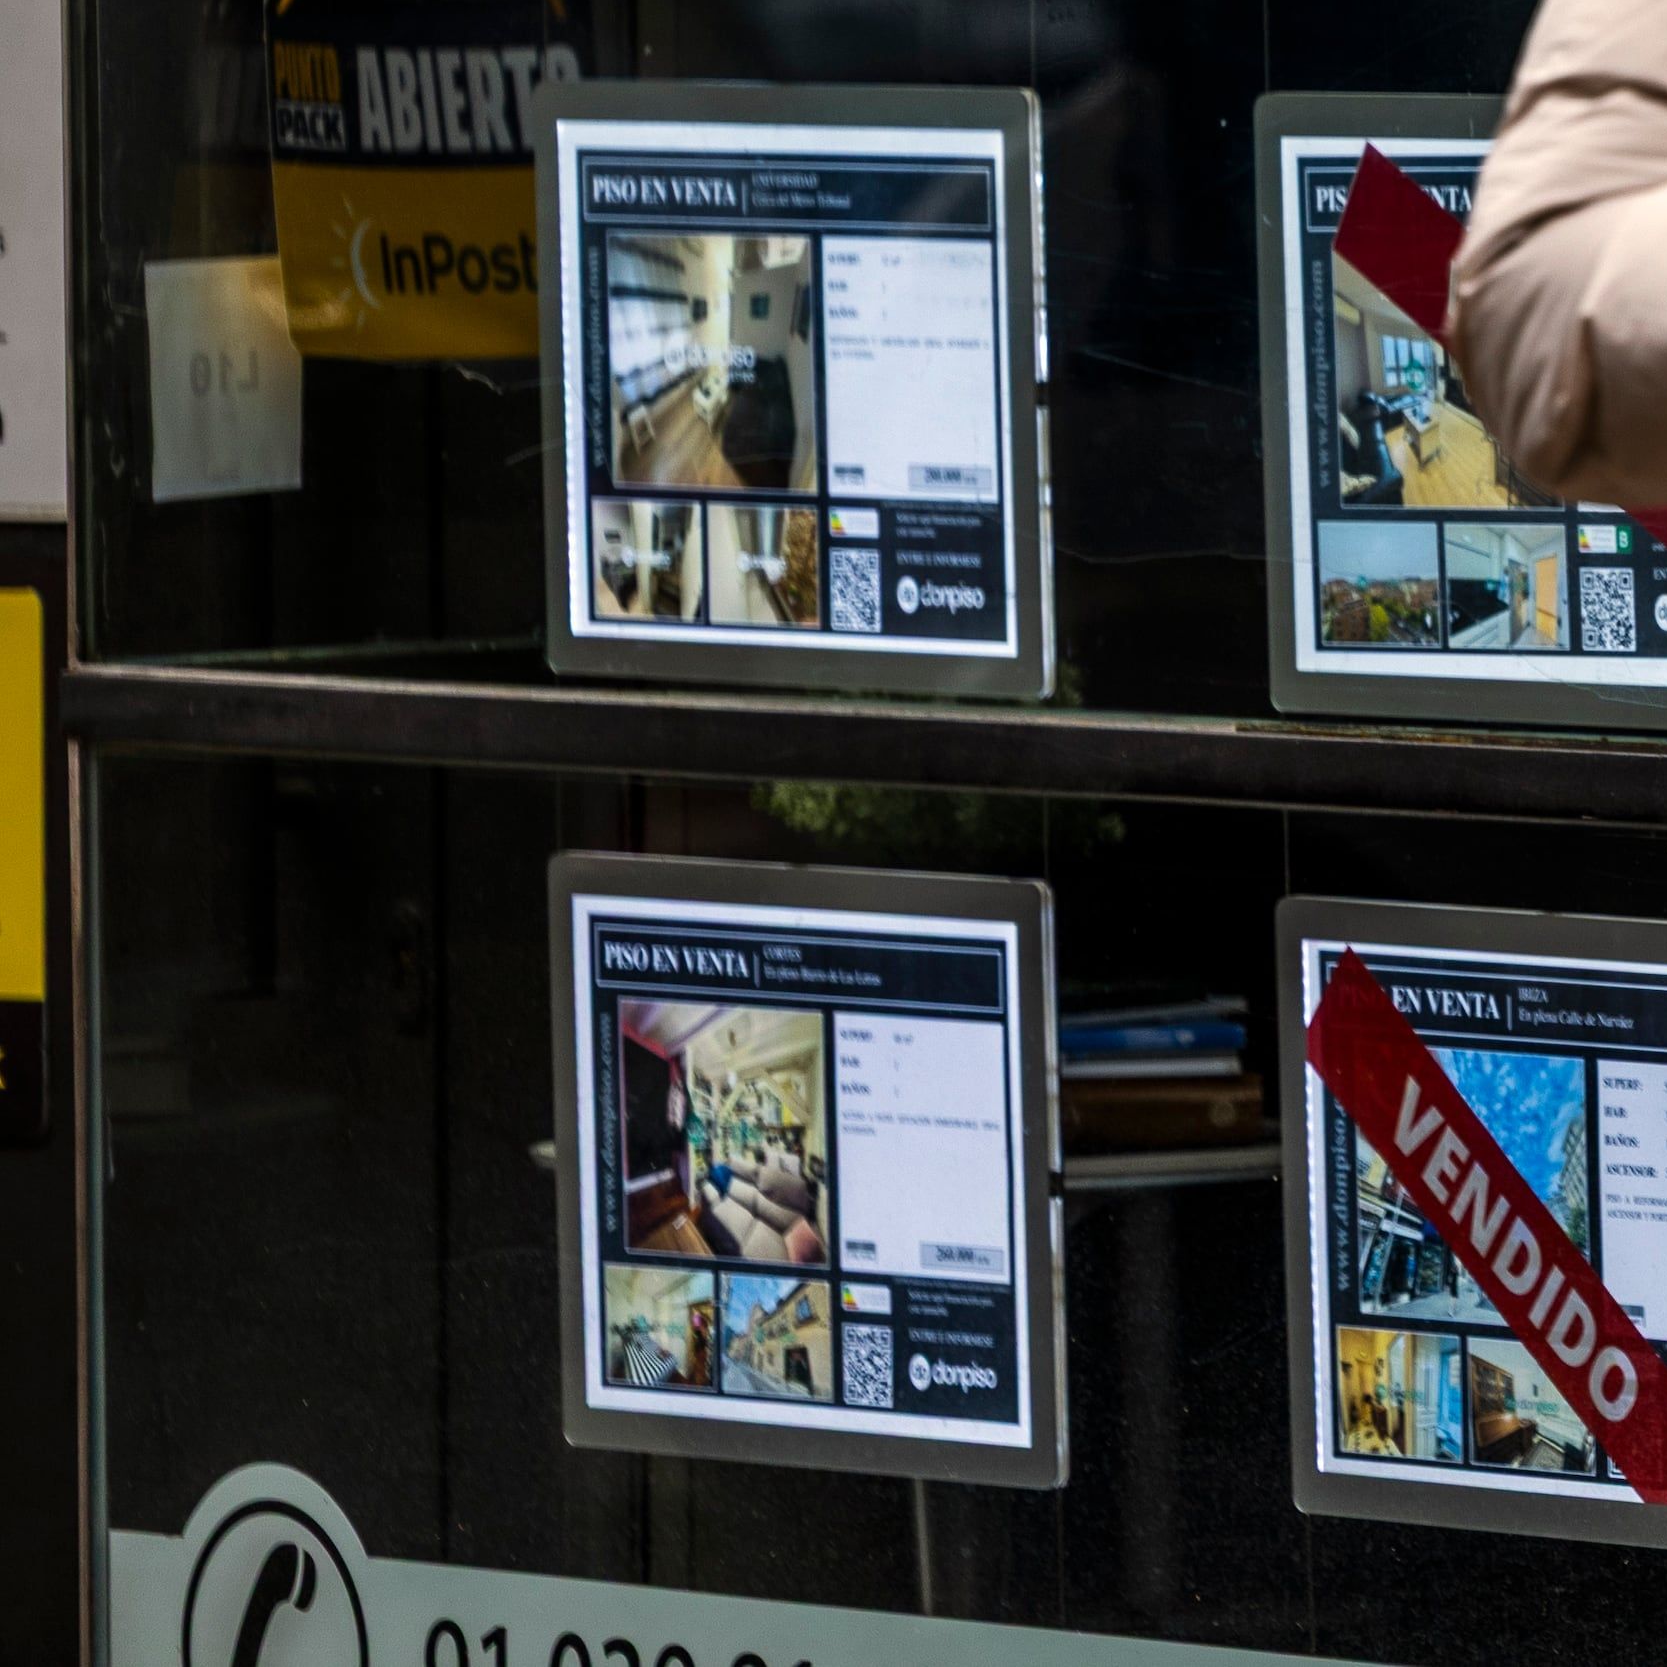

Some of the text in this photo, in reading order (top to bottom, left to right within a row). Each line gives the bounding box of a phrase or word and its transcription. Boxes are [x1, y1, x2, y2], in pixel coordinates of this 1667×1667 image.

[592, 175, 736, 206] PISO EN VENTA
[381, 231, 537, 293] InPost
[604, 941, 749, 978] PISO EN VENTA
[1391, 985, 1500, 1020] EN VENTA
[1392, 1073, 1639, 1423] VENDIDO
